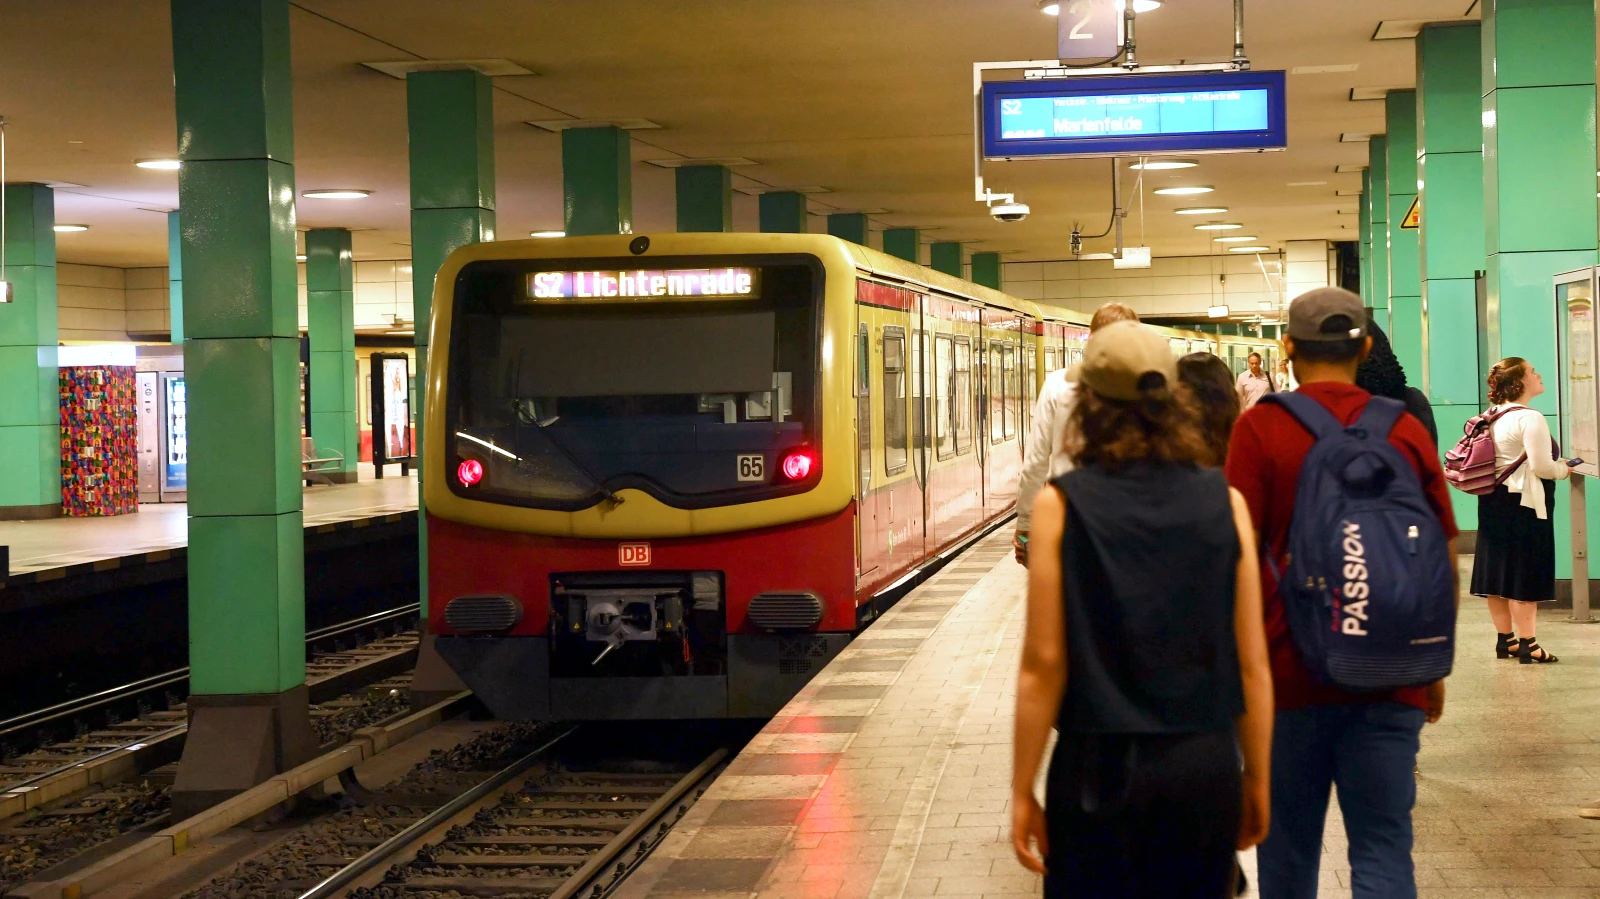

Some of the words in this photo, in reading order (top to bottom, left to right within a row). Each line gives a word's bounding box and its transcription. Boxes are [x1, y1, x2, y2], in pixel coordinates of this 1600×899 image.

[1069, 0, 1093, 39] 2
[1002, 100, 1022, 115] S2
[1054, 115, 1142, 133] Marienfelde
[534, 272, 564, 298] S2
[576, 268, 751, 298] Lichtenrade
[740, 457, 763, 478] 65
[623, 547, 647, 562] DB
[1342, 520, 1370, 637] PASSION
